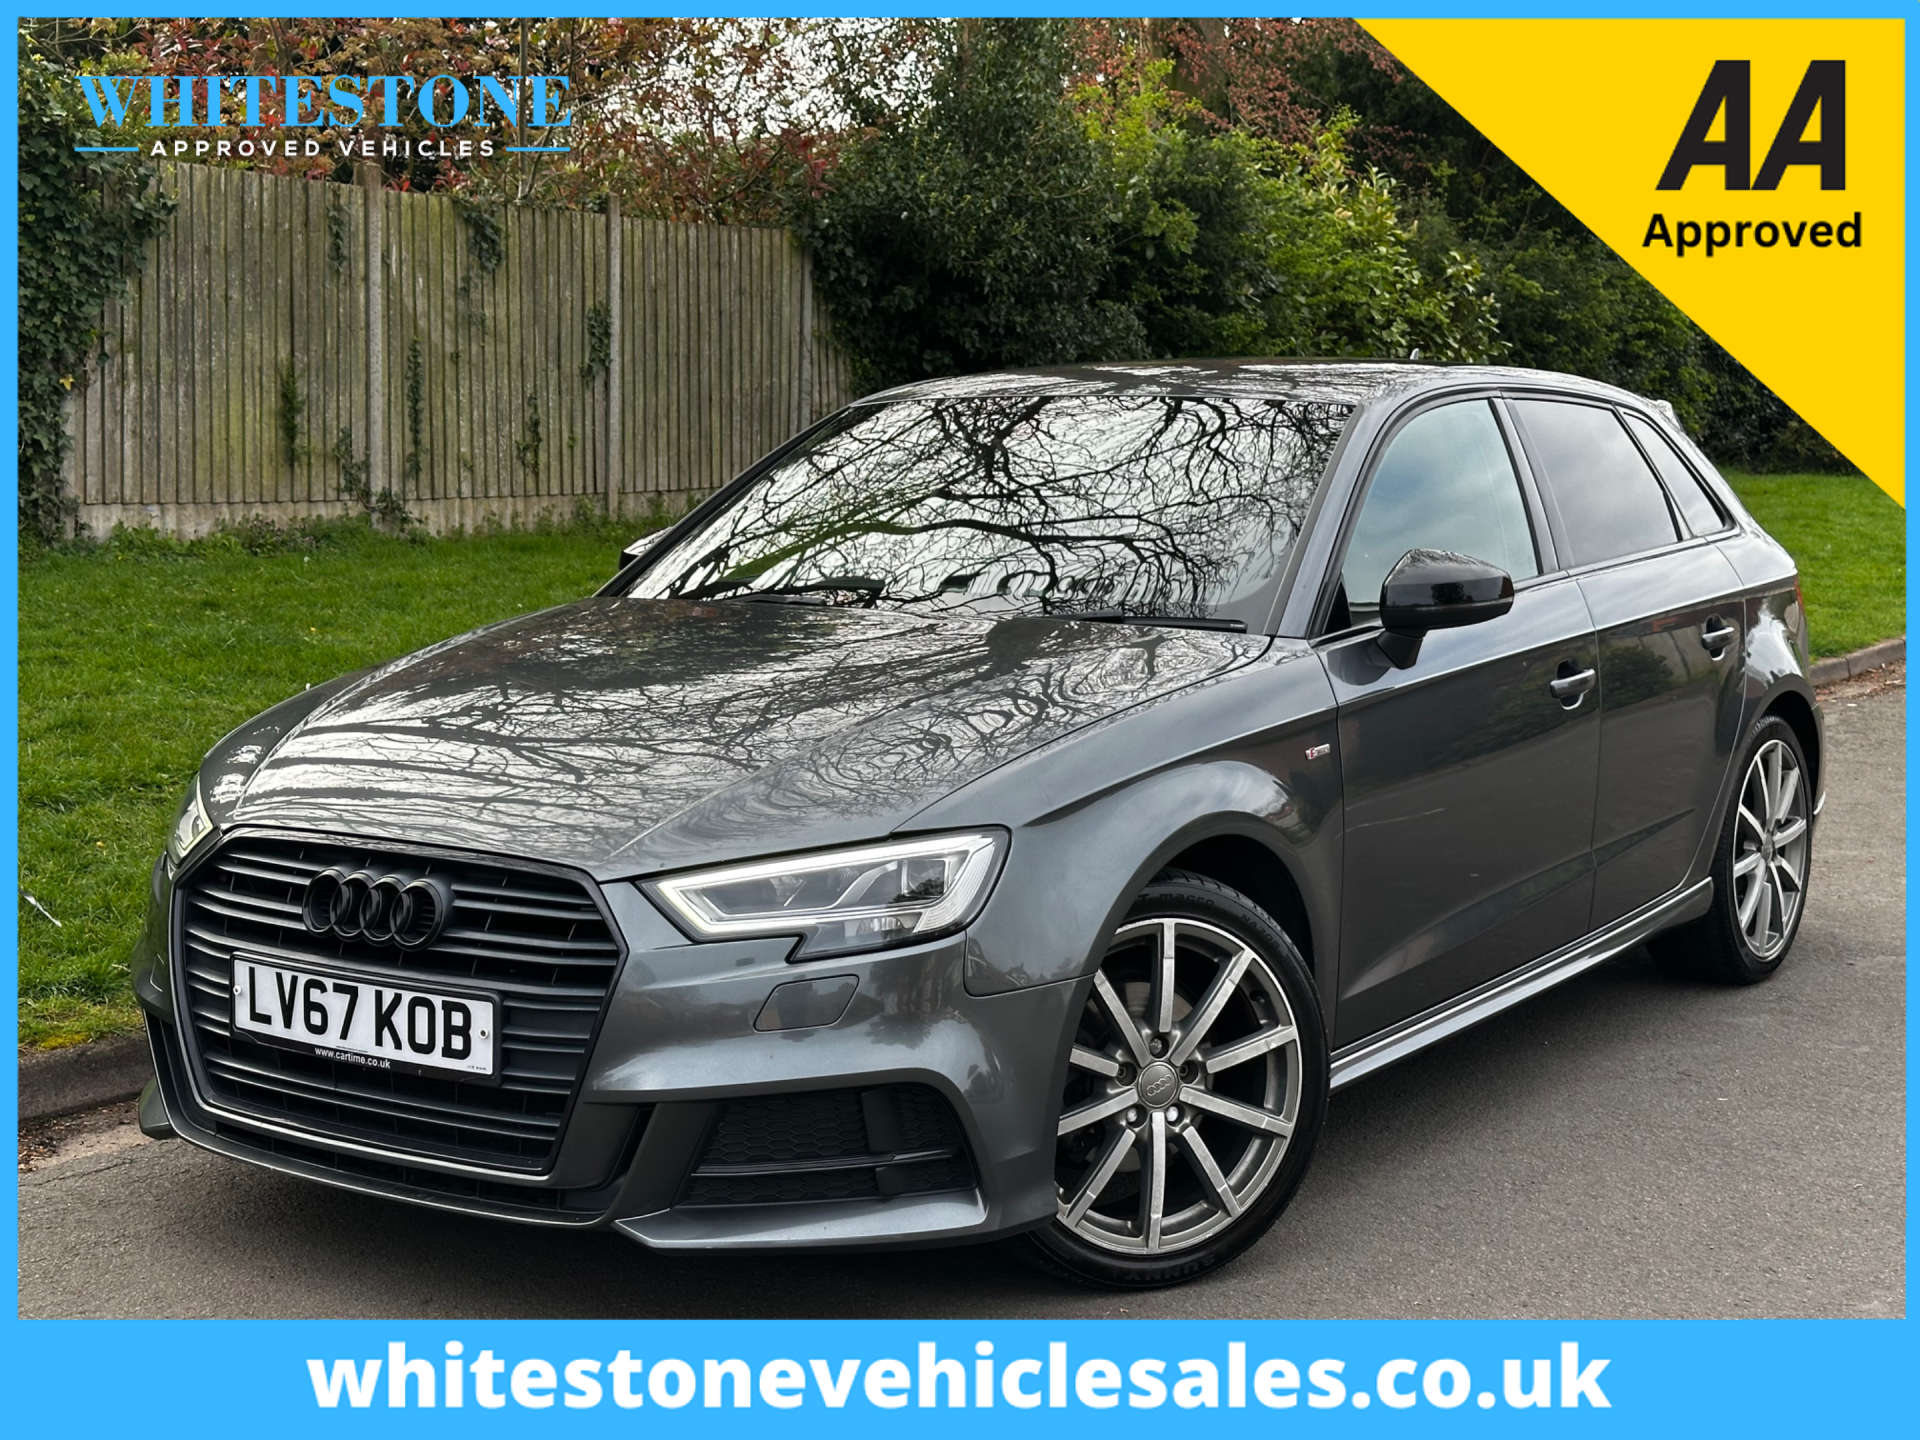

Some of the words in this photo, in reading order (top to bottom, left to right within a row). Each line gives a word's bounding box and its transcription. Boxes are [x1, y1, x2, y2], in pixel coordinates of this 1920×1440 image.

[248, 966, 359, 1040] LV67
[374, 989, 472, 1061] KOB
[314, 1047, 391, 1069] www.cartime.co.uk
